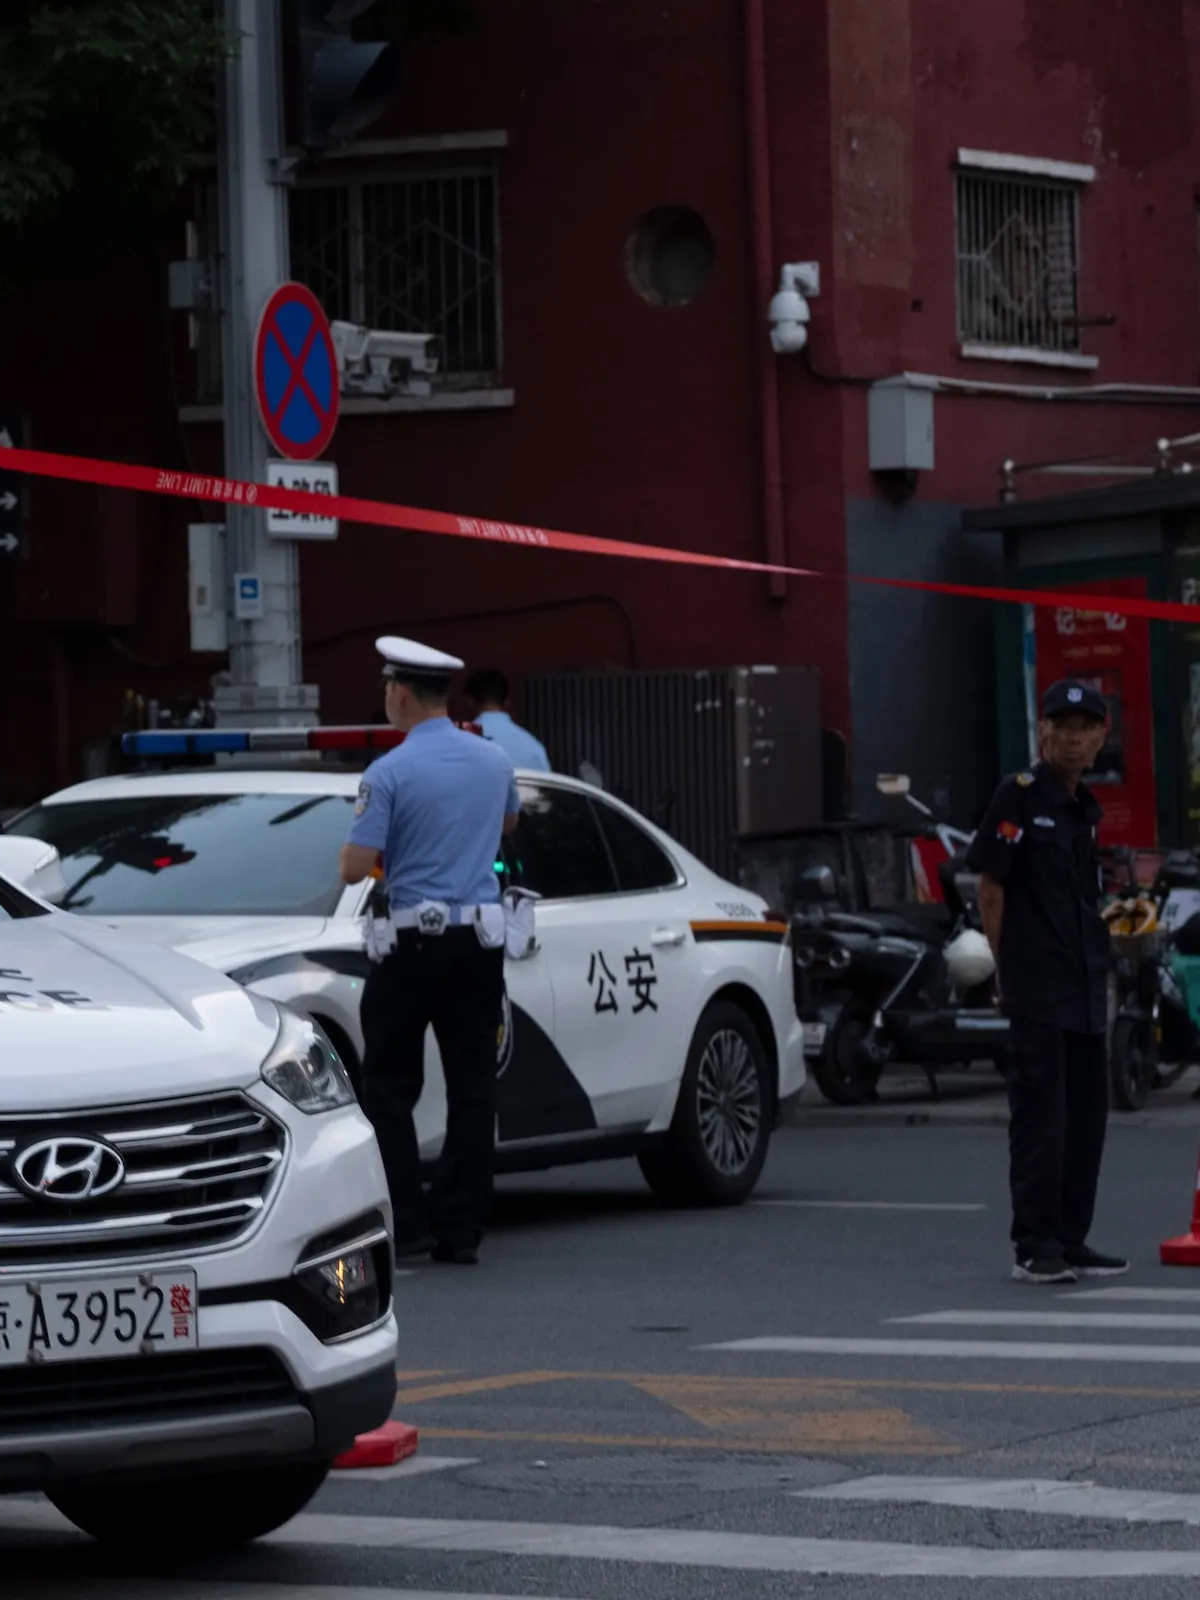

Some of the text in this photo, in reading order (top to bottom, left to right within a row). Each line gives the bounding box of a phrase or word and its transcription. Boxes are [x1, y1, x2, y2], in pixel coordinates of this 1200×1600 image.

[156, 471, 181, 490] LINE
[182, 476, 212, 495] LIMIT
[587, 947, 659, 1015] 公安
